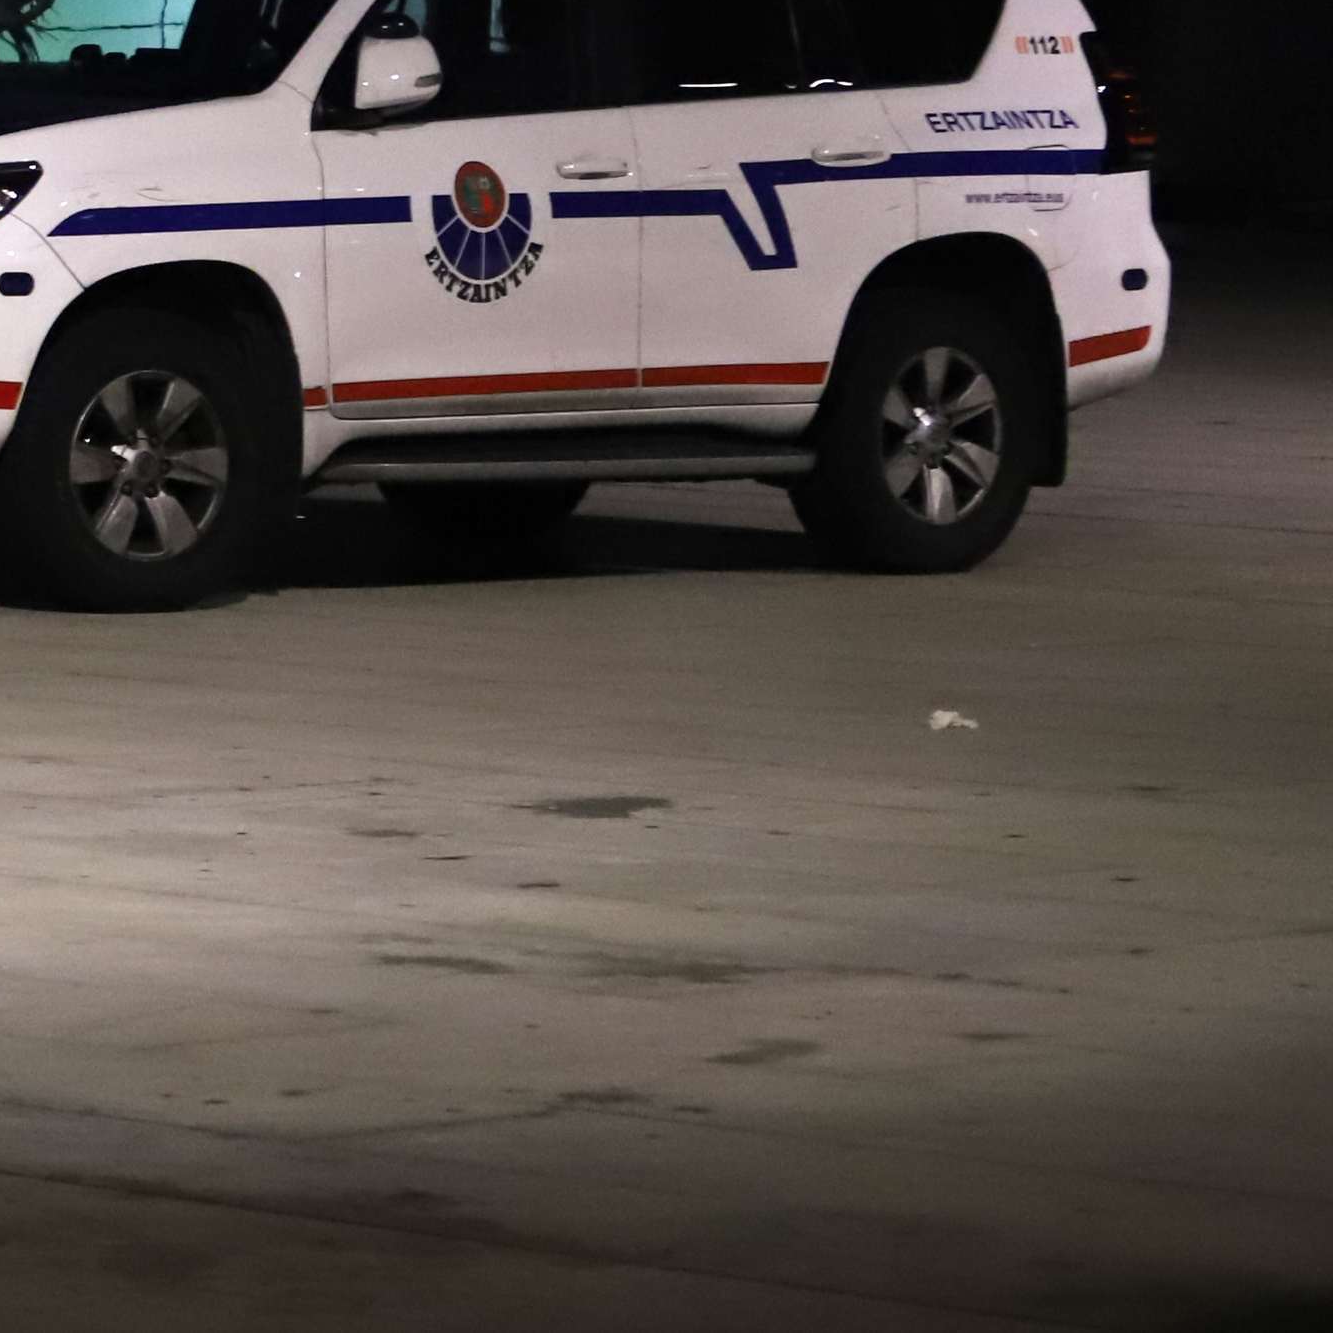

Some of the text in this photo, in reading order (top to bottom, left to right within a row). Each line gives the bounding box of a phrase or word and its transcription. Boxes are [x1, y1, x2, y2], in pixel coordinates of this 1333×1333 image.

[1030, 36, 1060, 54] 112
[924, 109, 1080, 133] ERTZAINTZA
[424, 241, 545, 304] ERTZAINTZA
